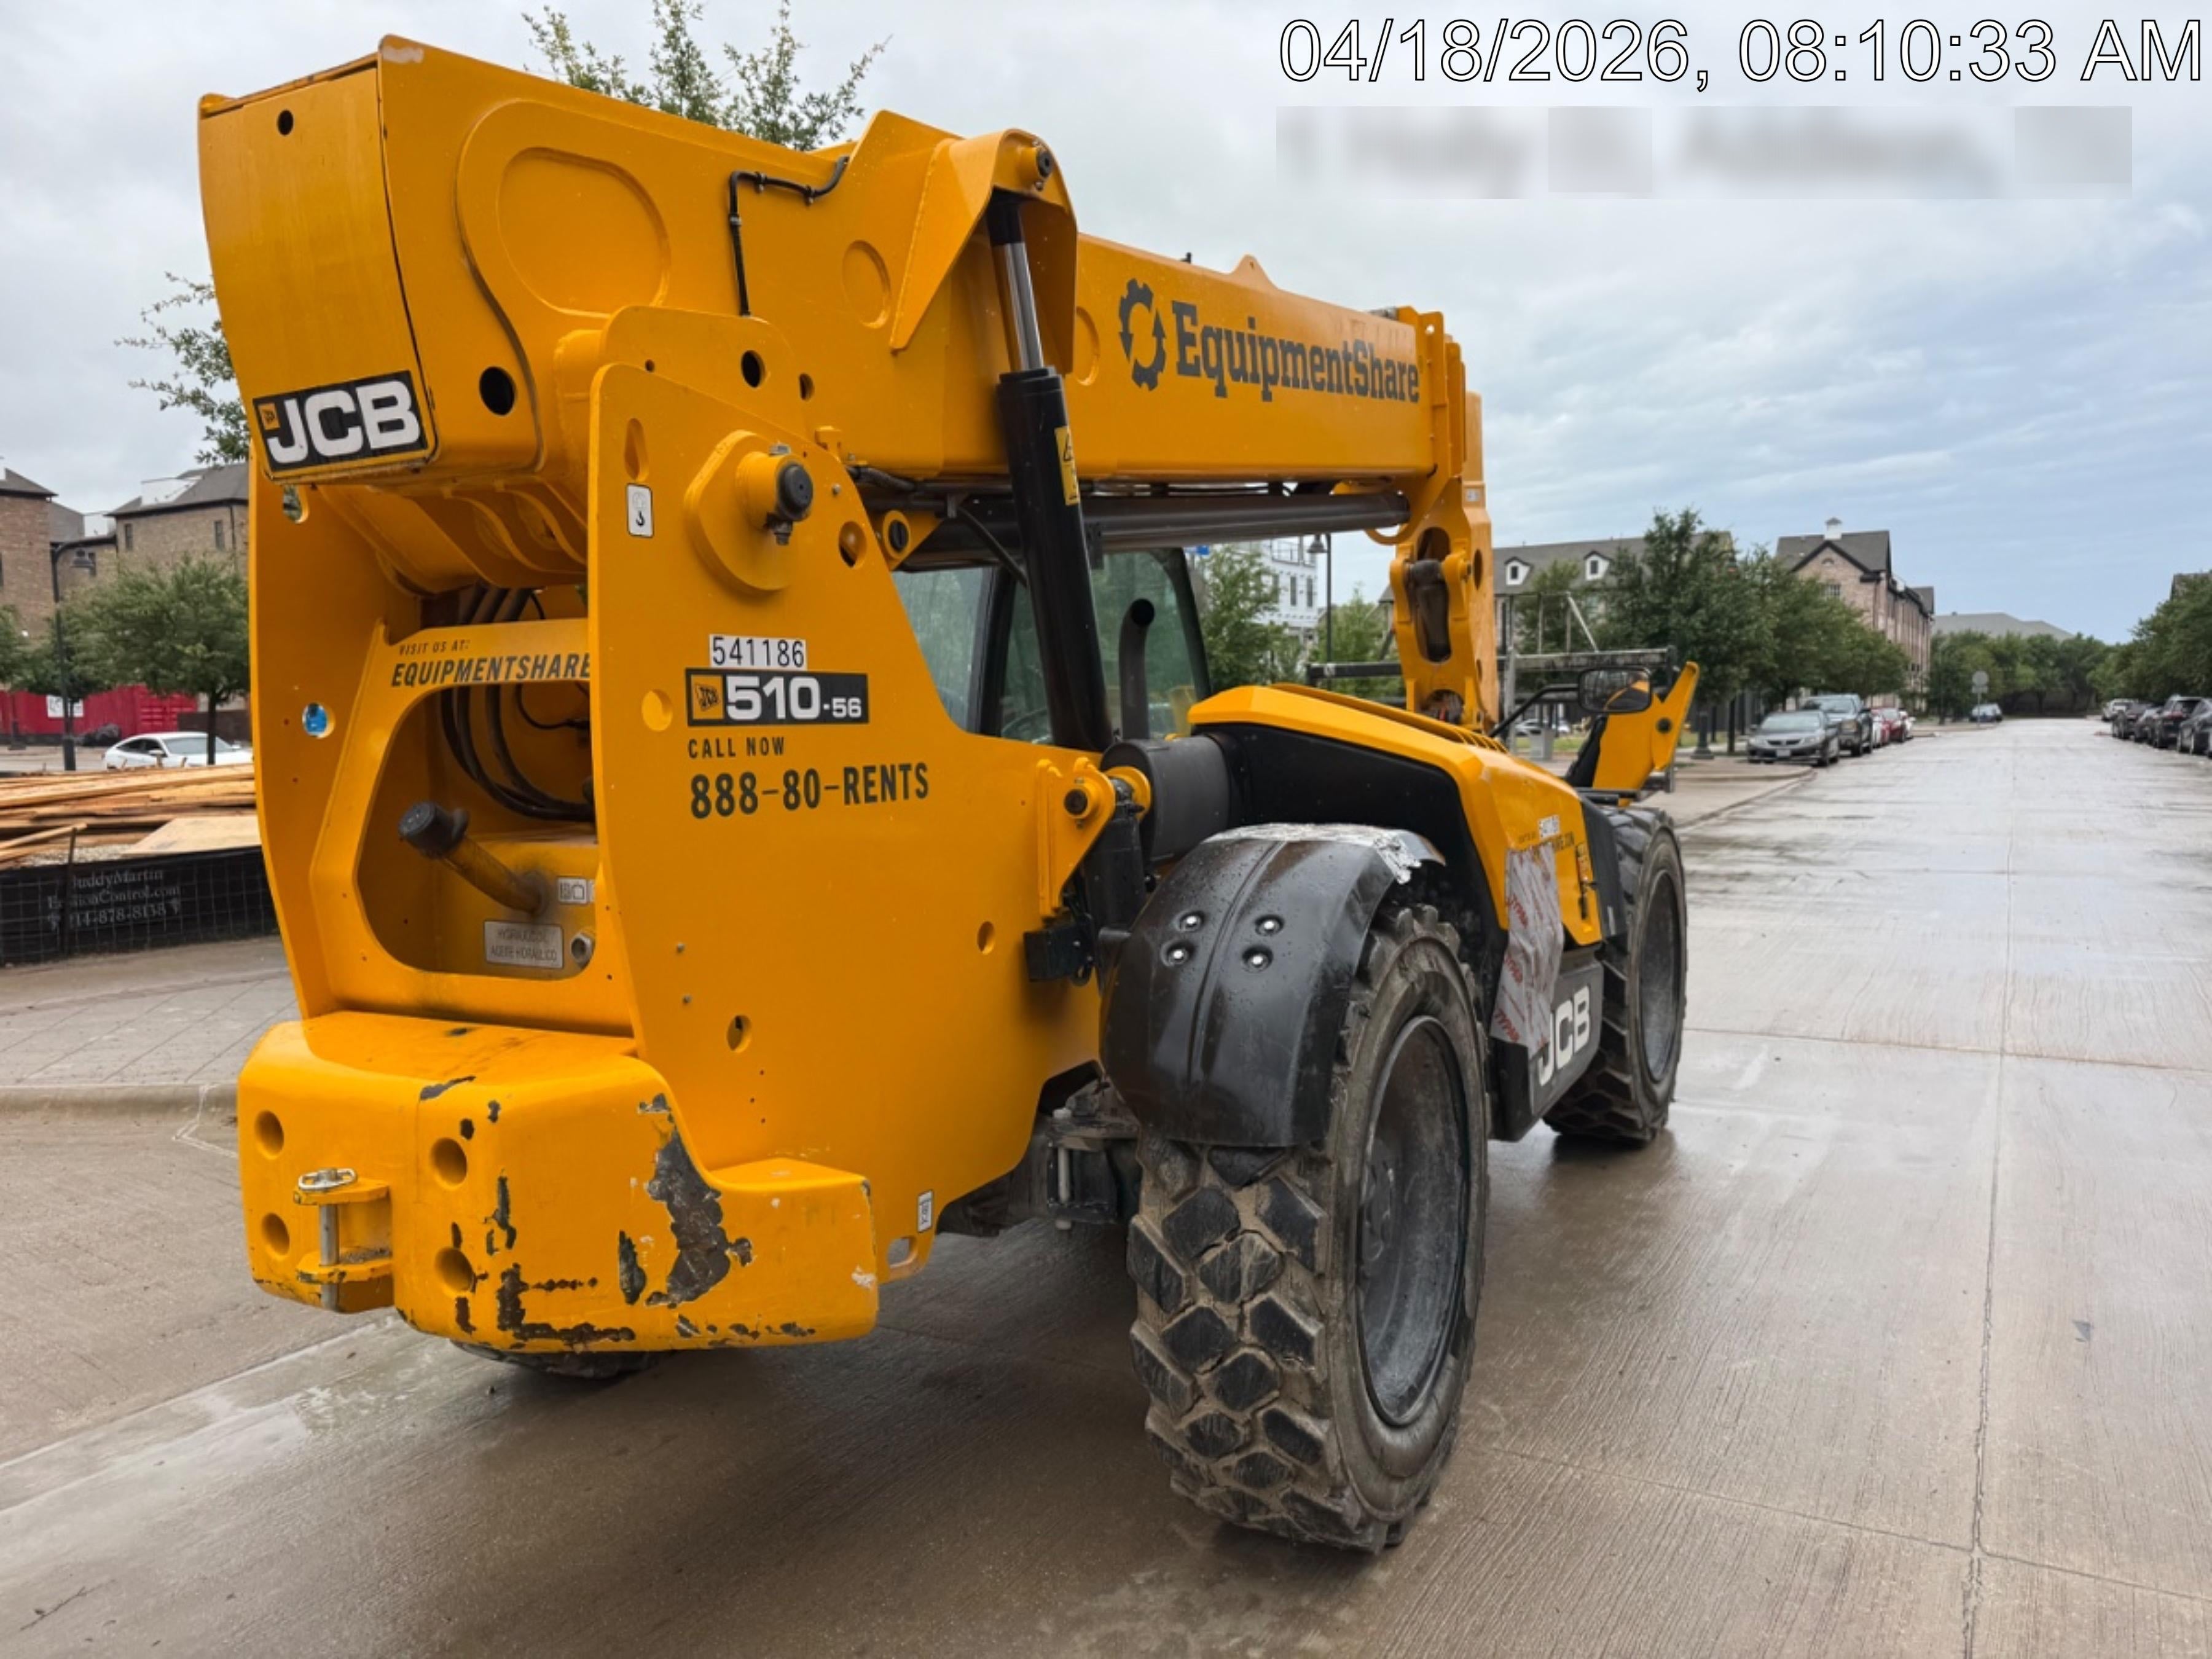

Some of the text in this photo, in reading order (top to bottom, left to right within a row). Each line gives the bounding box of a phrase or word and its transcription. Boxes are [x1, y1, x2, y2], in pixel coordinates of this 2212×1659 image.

[1171, 299, 1419, 403] EquipmentShare
[267, 381, 420, 463] JCB
[399, 643, 428, 656] VISIT
[433, 642, 447, 653] US
[712, 637, 805, 668] 541186
[688, 737, 785, 759] CALL NOW
[691, 763, 929, 819] 888-80-RENTS
[1537, 985, 1590, 1086] JCB
